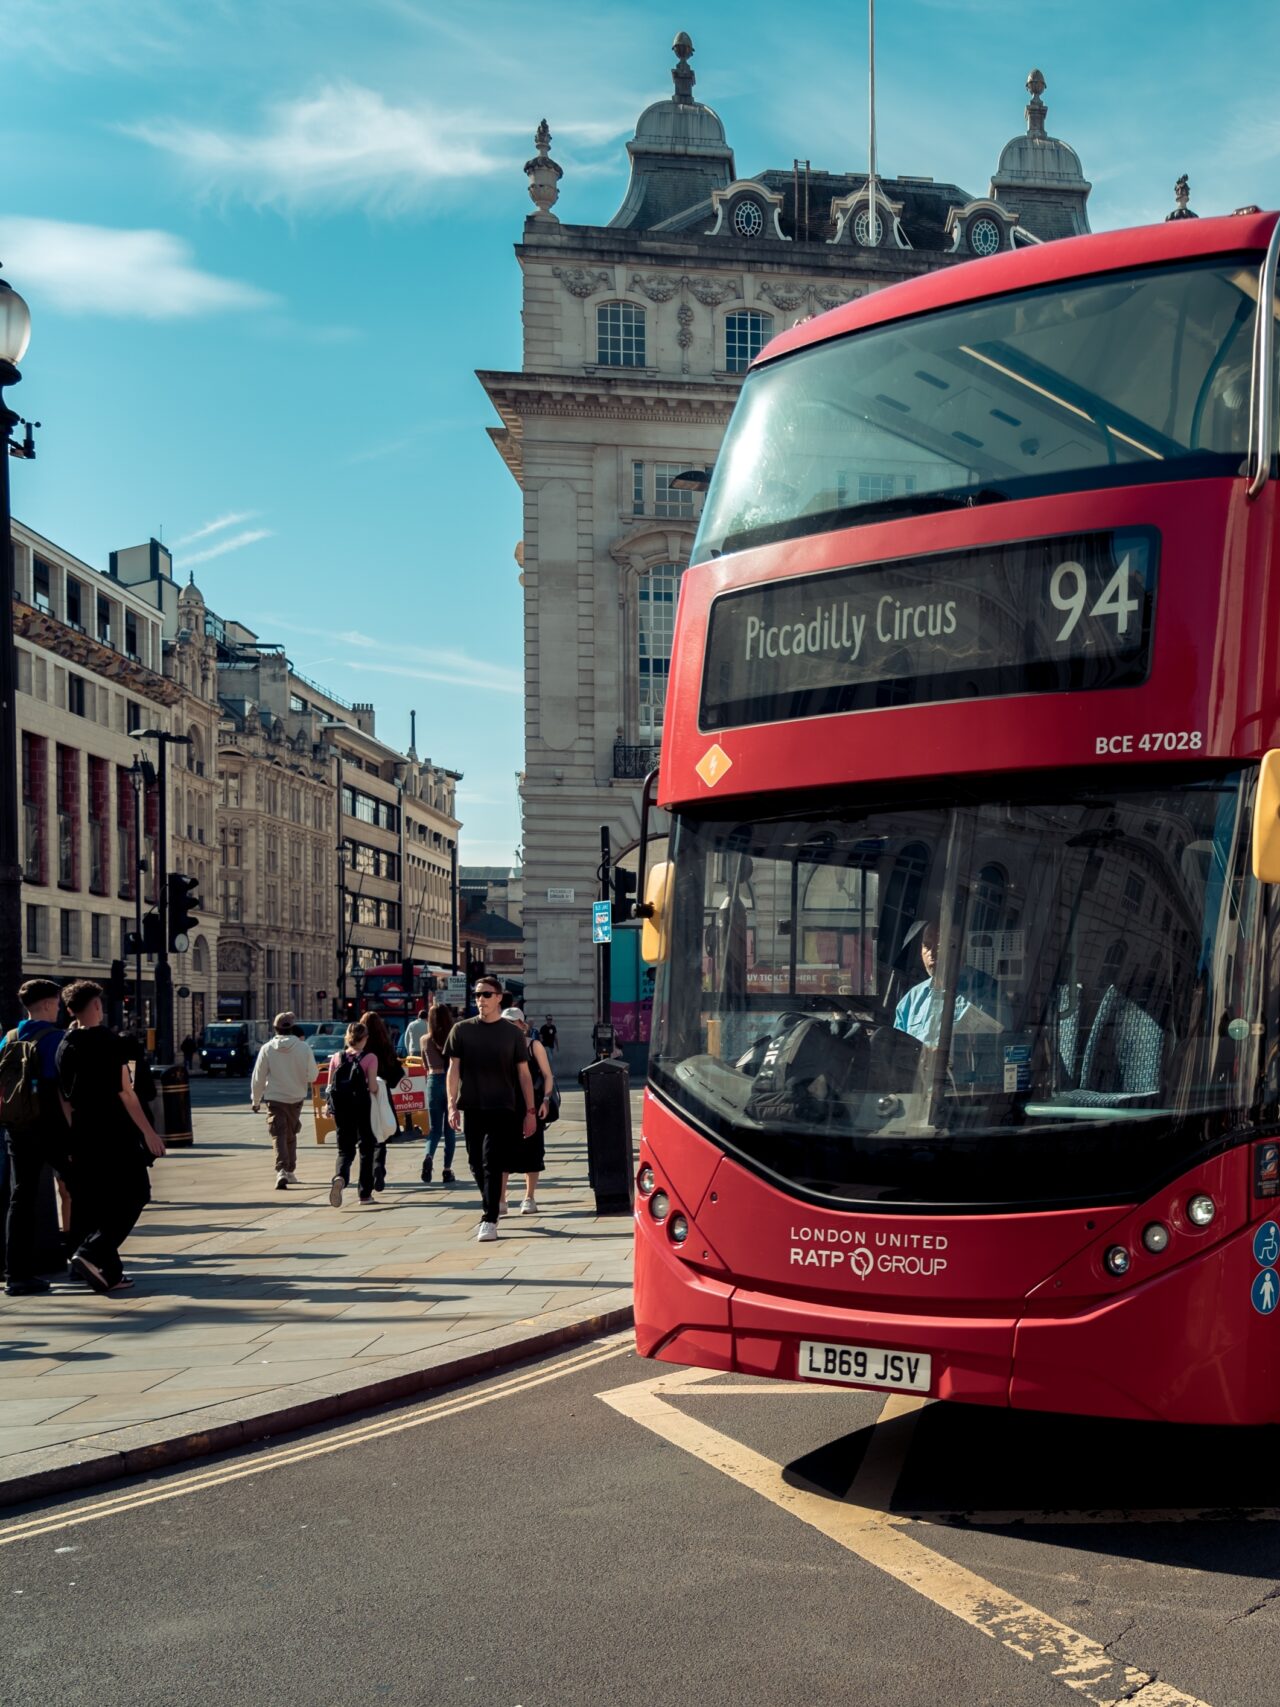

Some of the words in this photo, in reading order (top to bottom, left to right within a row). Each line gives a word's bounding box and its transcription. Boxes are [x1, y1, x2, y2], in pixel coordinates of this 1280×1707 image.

[1050, 552, 1139, 642] 94
[745, 602, 866, 661] Piccadilly
[876, 595, 957, 643] Circus
[1095, 735, 1134, 755] BCE
[1138, 731, 1202, 752] 47028
[401, 1093, 414, 1102] No
[790, 1226, 866, 1245] LONDON
[875, 1231, 948, 1250] UNITED
[790, 1247, 845, 1268] RATP
[877, 1254, 948, 1276] GROUP
[808, 1346, 867, 1378] LB69
[874, 1354, 920, 1384] JSV
